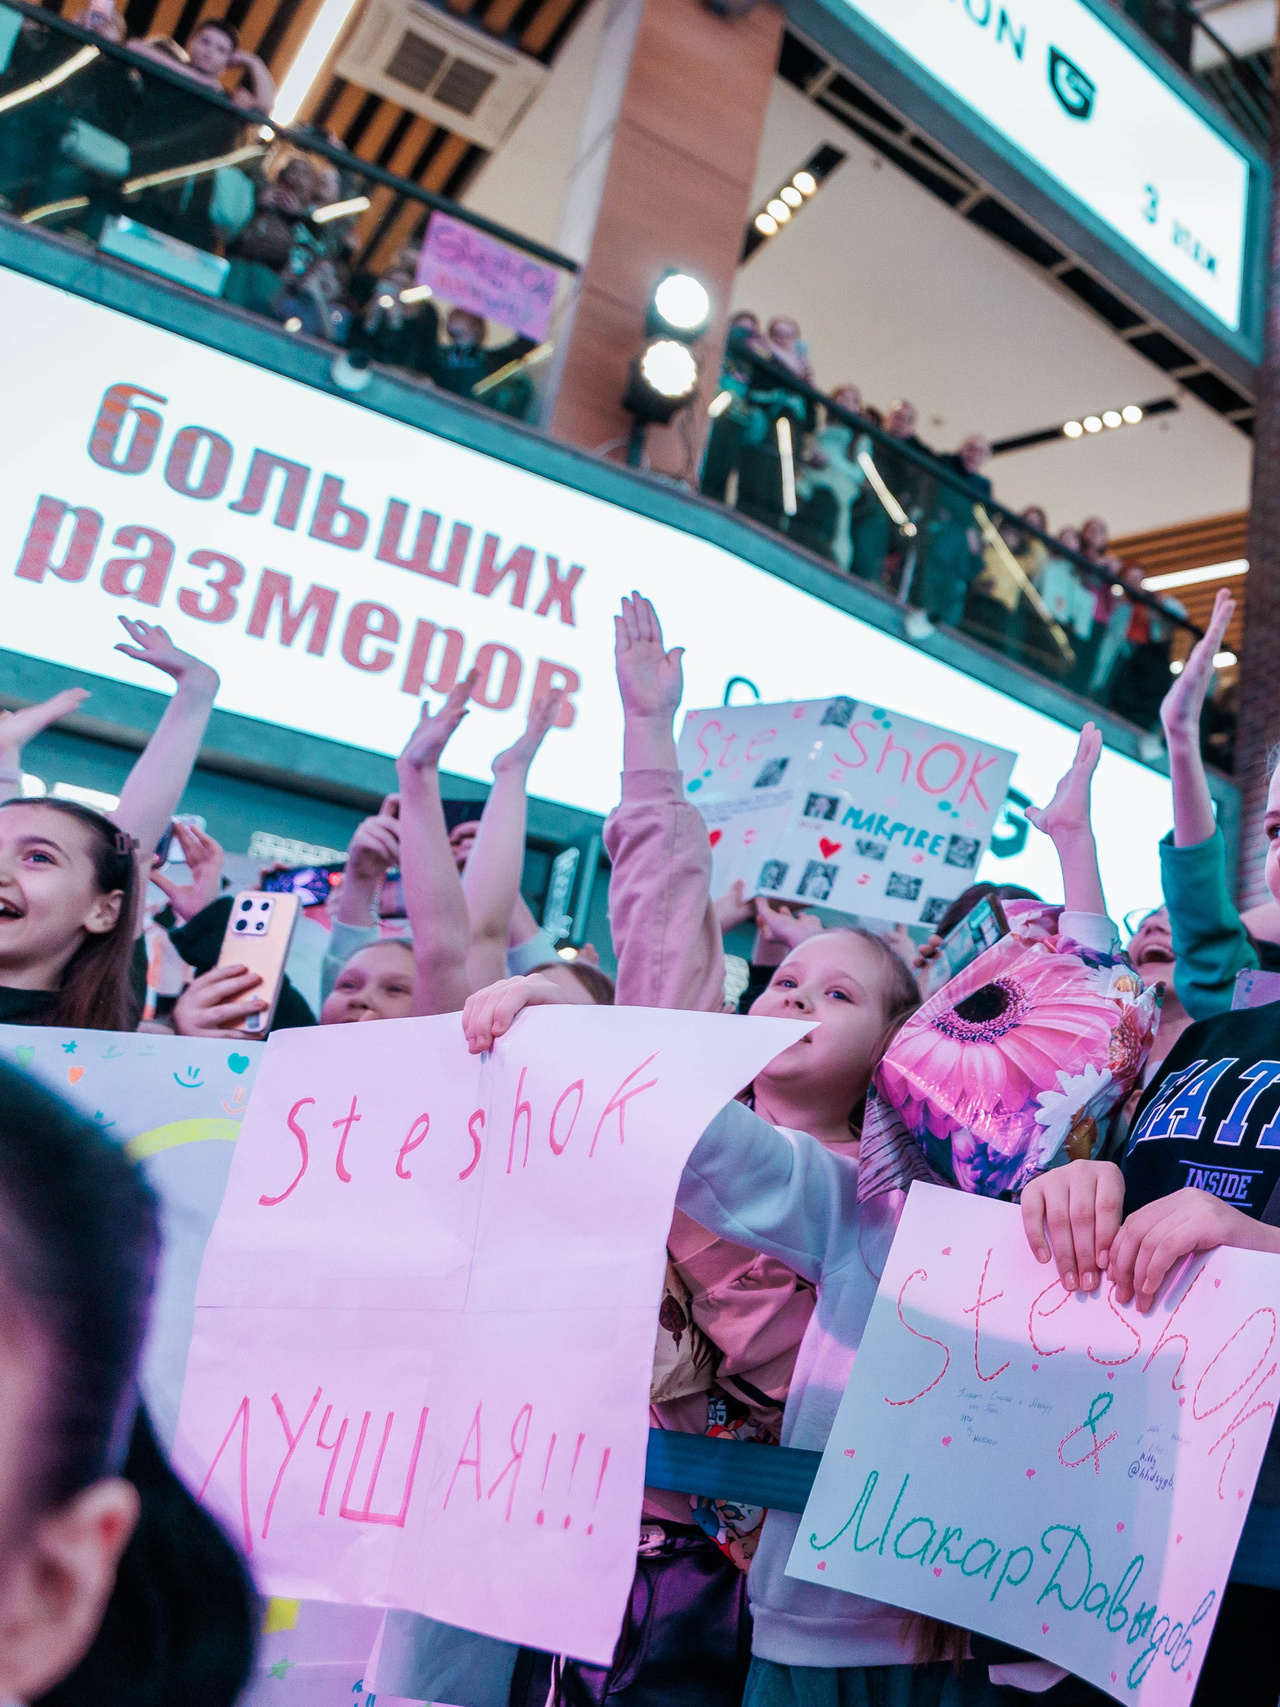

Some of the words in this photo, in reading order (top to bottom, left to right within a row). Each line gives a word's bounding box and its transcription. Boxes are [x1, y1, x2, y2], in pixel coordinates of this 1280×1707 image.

[14, 493, 582, 729] размеров
[87, 382, 587, 627] больших
[1185, 1167, 1253, 1199] INSIDE
[1057, 1391, 1120, 1475] &
[810, 1470, 1034, 1602] Макар
[1039, 1525, 1216, 1690] Давыдов
